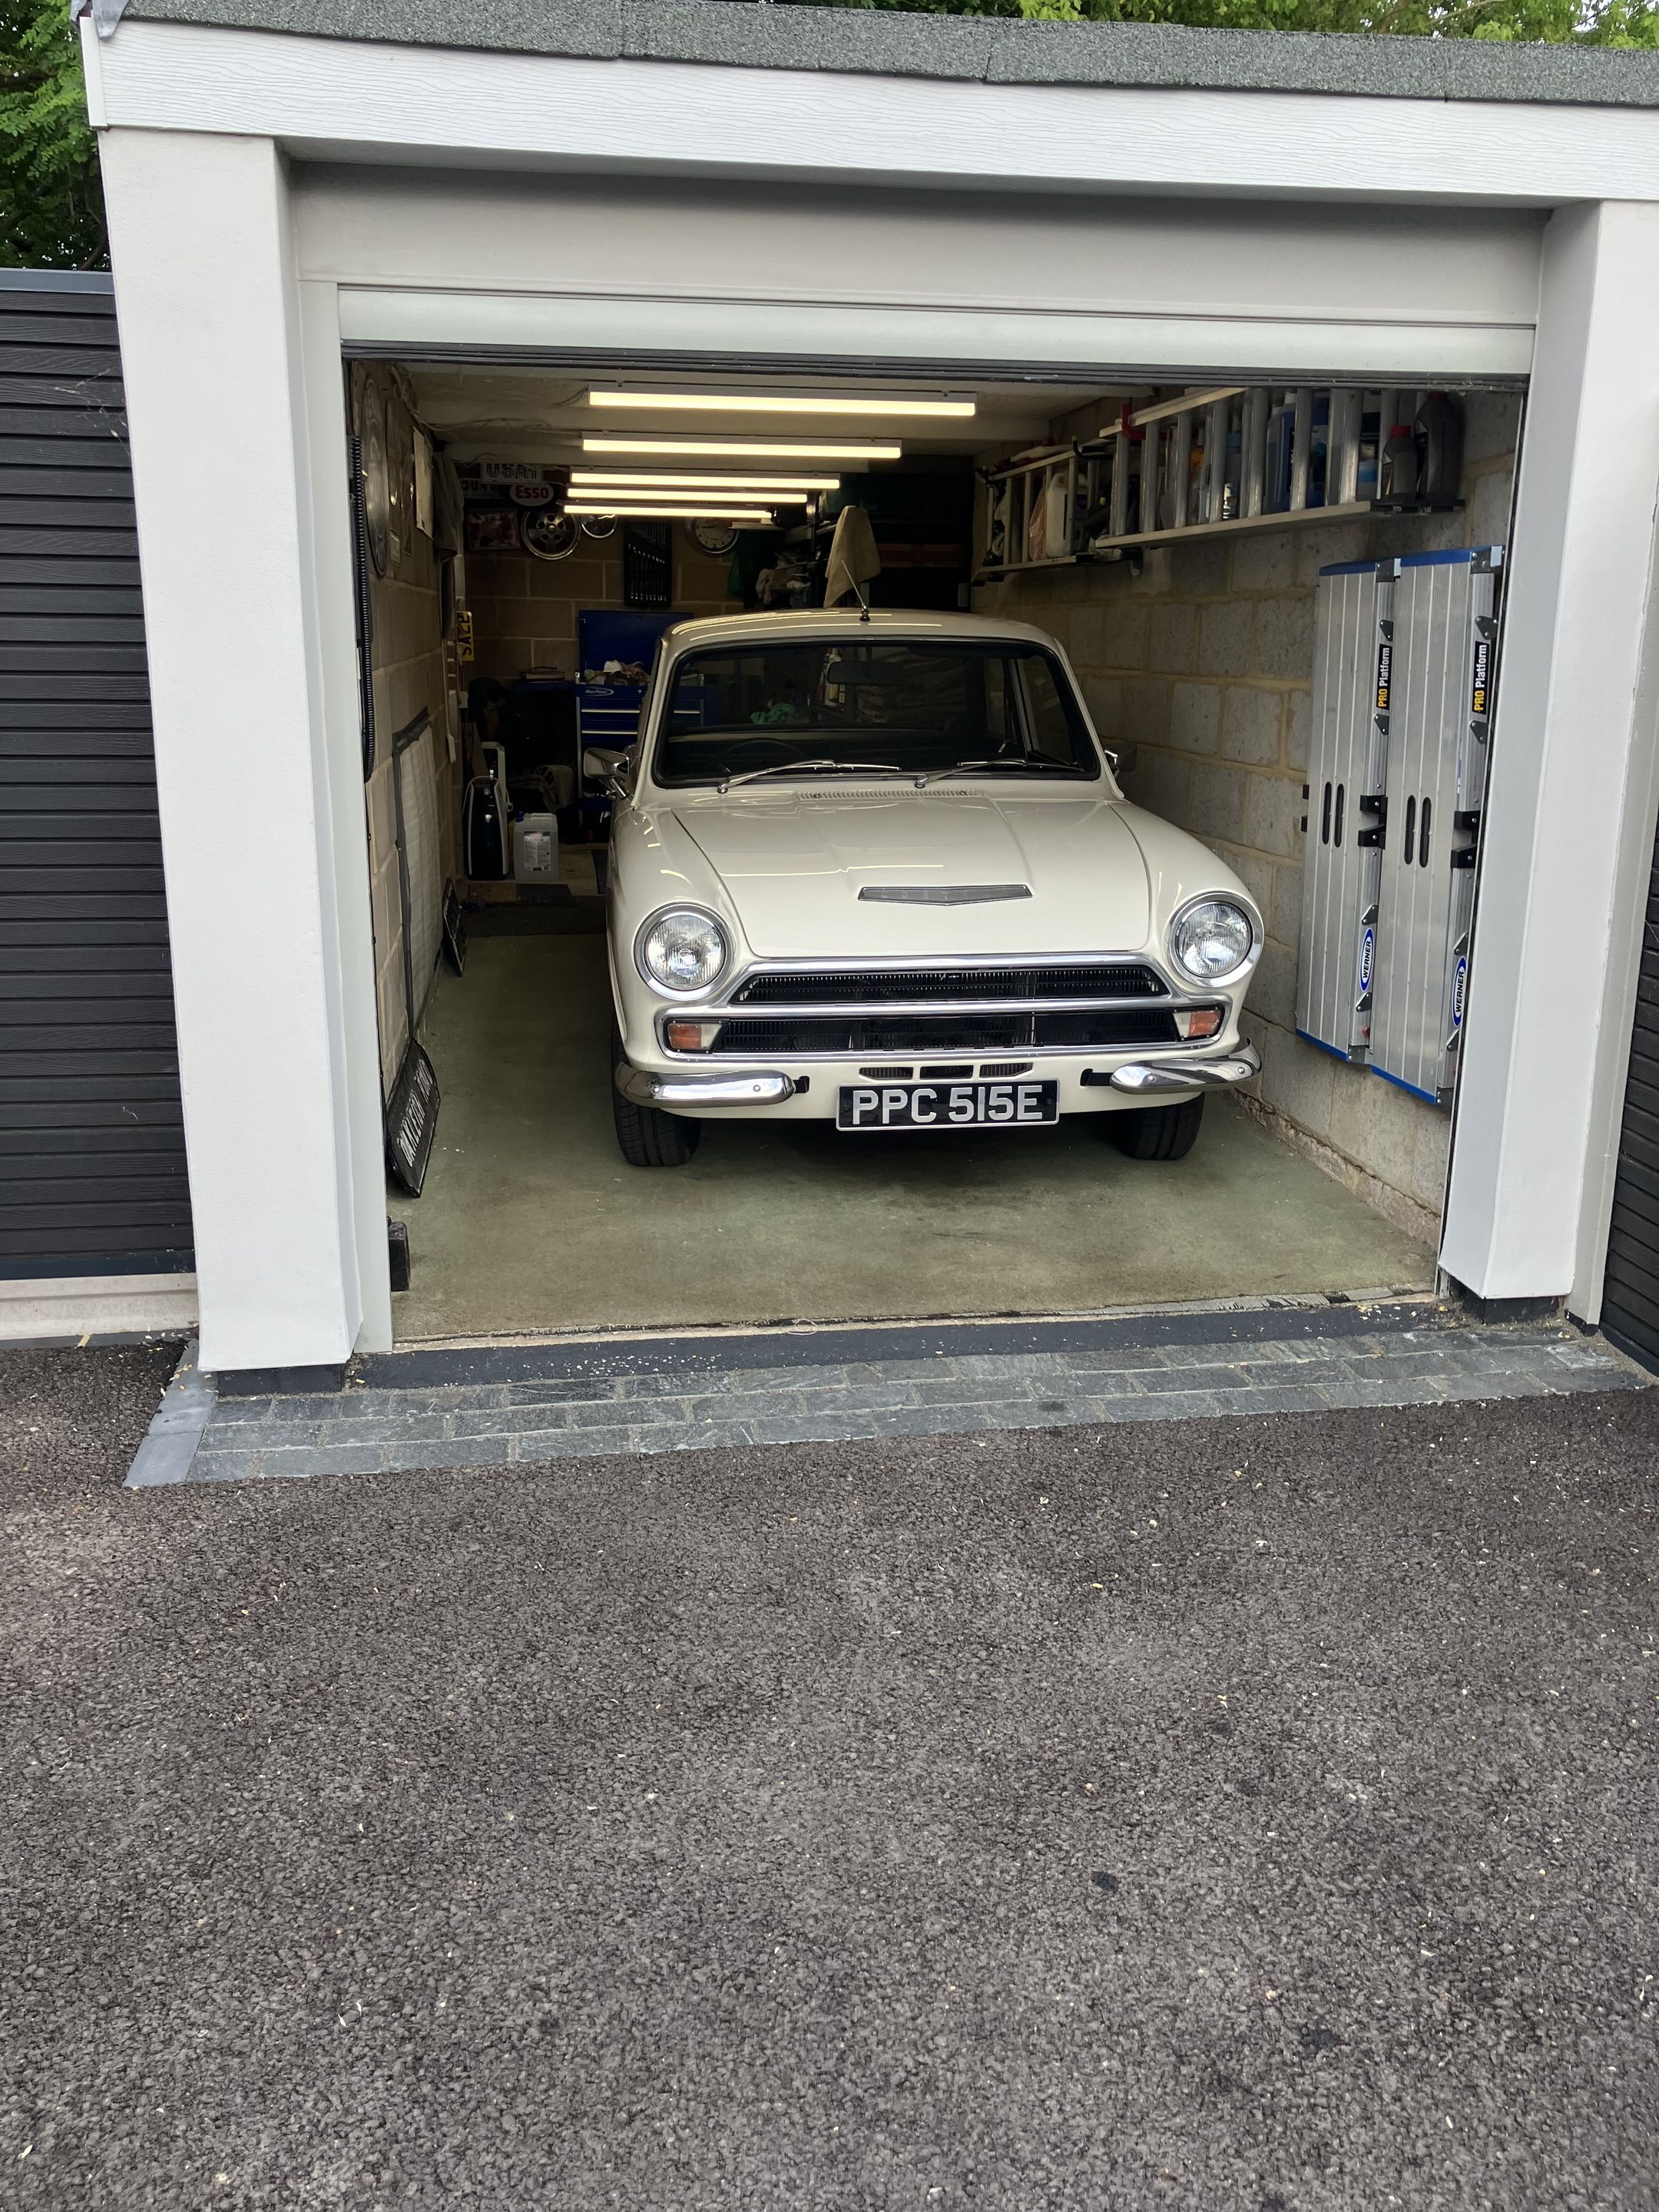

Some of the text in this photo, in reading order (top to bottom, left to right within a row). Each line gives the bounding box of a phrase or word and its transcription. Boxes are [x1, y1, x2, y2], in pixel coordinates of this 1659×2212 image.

[1378, 647, 1390, 707] PRO Platform
[1473, 644, 1487, 711] PRO Platform
[1363, 940, 1372, 979] WERNER
[1455, 970, 1465, 1013] WERNER
[397, 1059, 433, 1167] OAKLEIGH ROAD
[853, 1084, 1043, 1125] PPC 515E
